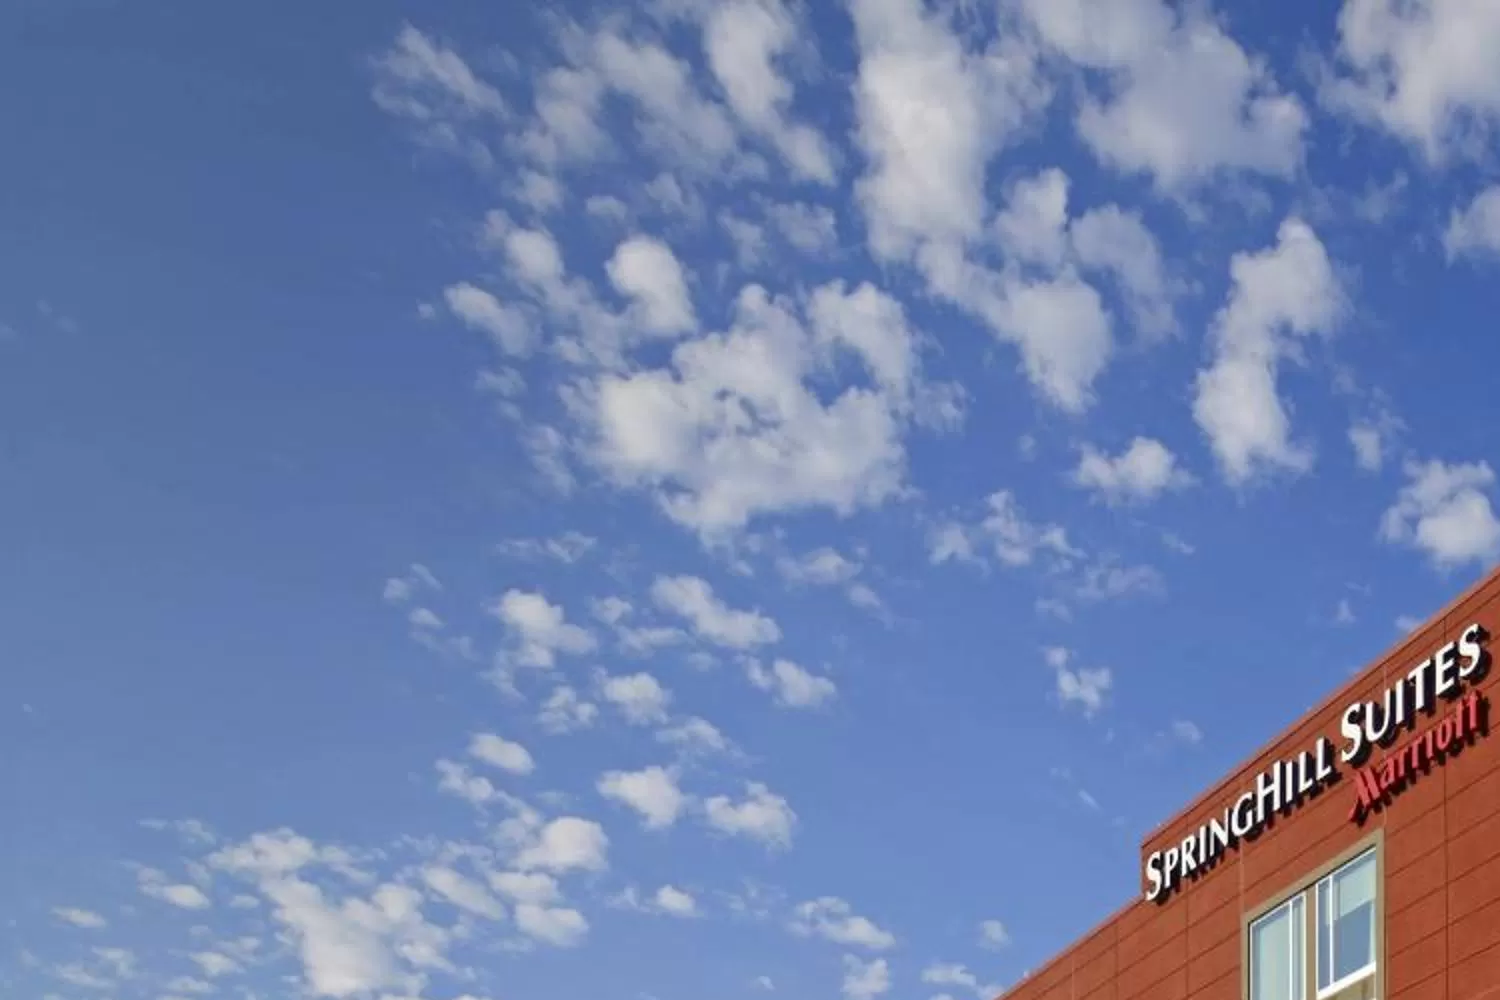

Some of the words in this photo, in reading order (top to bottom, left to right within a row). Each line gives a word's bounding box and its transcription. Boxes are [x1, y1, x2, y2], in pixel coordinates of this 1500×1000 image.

[1145, 737, 1332, 900] SPRINGHILL
[1341, 623, 1481, 762] SUITES
[1348, 690, 1484, 822] Marriott
